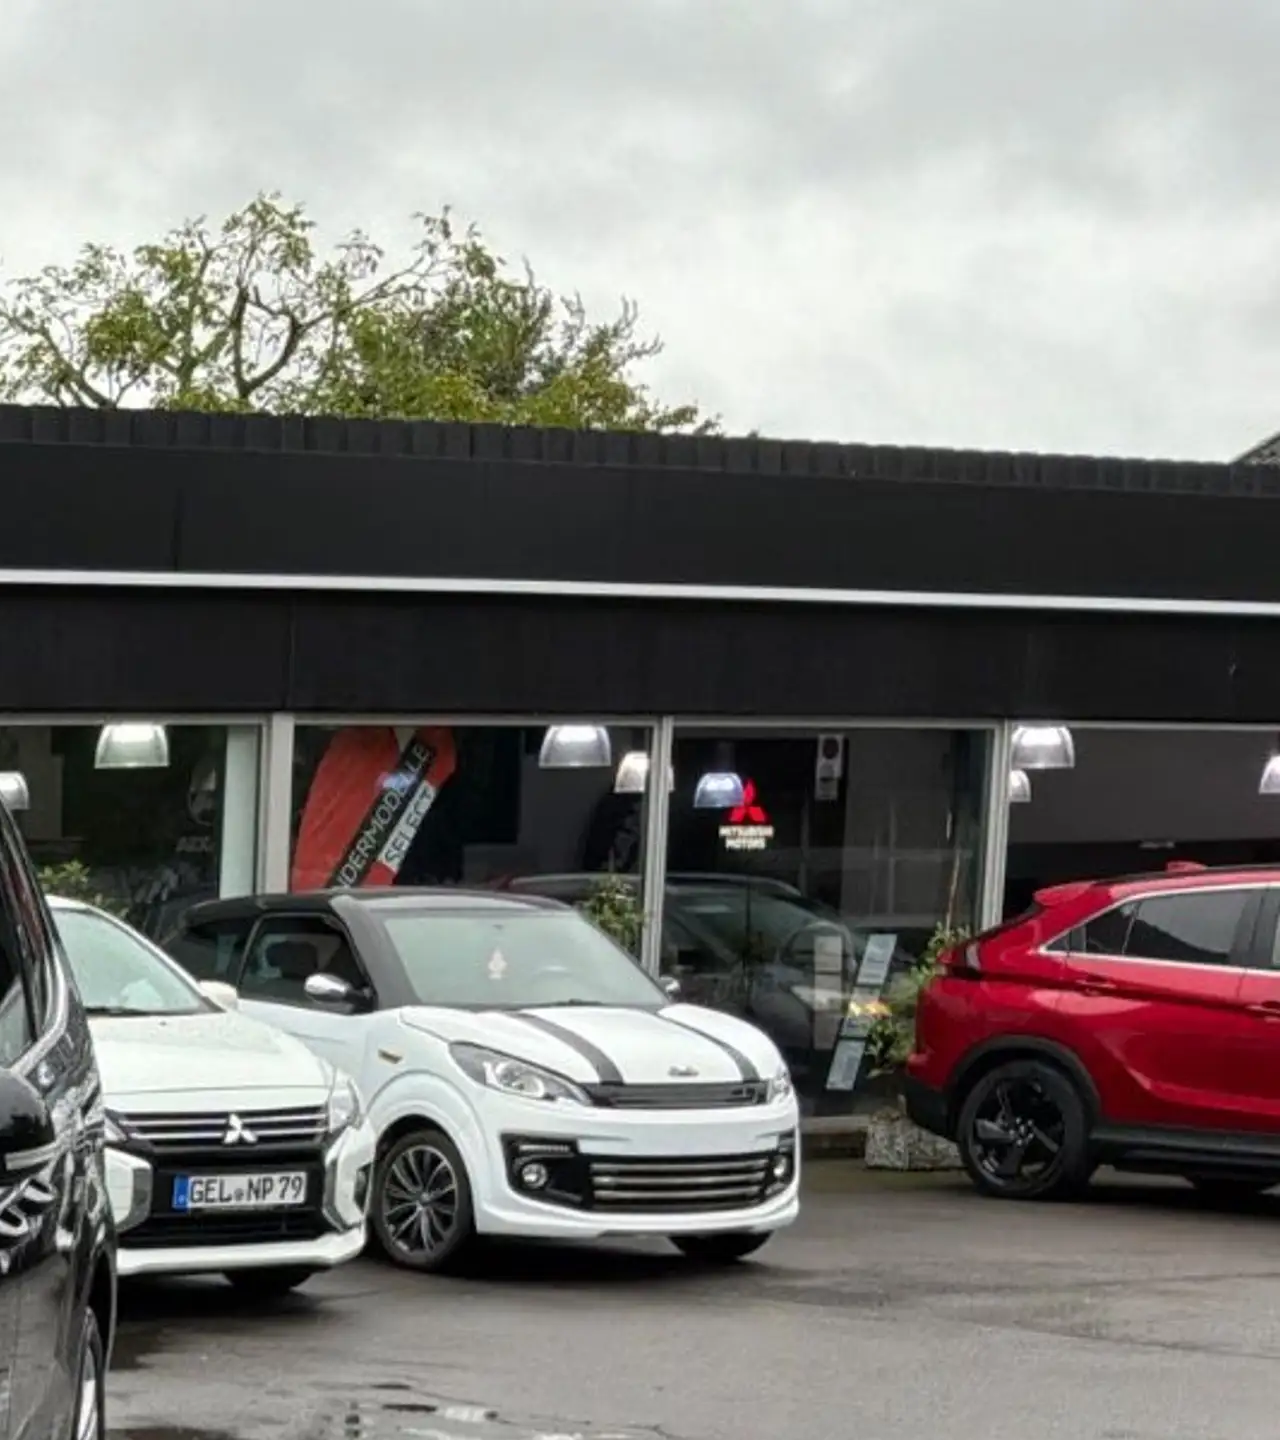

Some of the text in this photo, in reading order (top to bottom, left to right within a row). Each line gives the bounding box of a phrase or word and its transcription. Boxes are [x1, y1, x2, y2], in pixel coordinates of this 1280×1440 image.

[384, 788, 434, 863] SELECT
[191, 1175, 304, 1204] GEL NP 79
